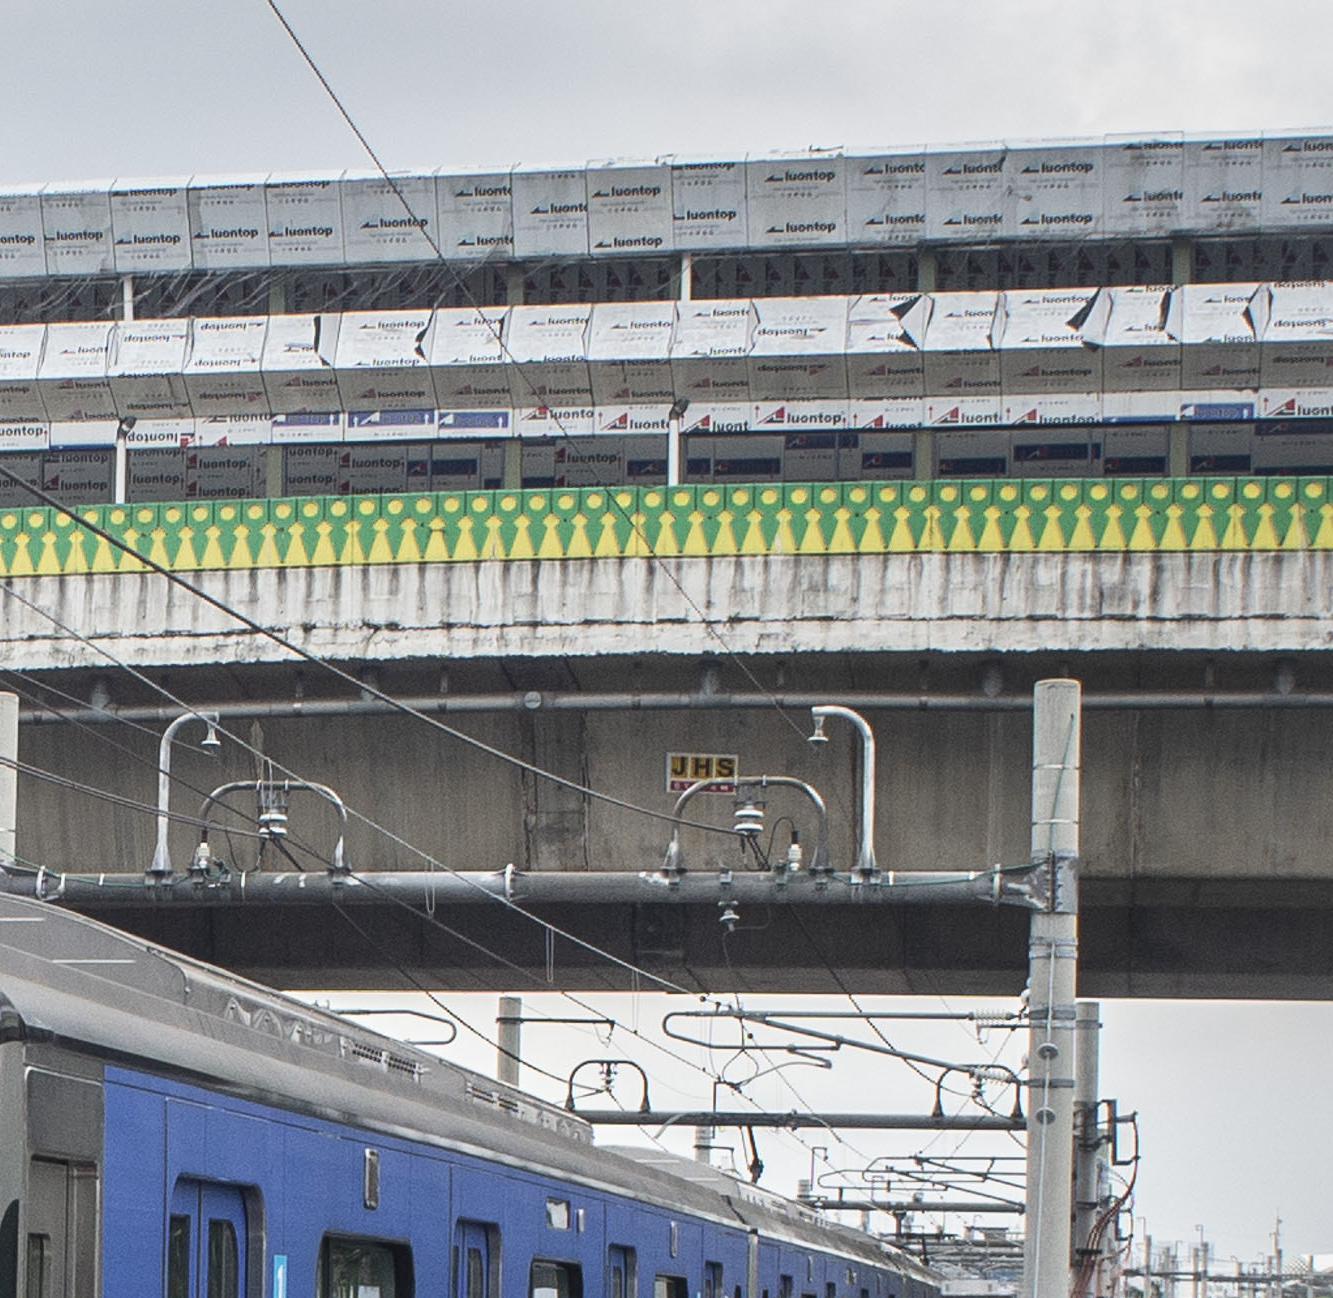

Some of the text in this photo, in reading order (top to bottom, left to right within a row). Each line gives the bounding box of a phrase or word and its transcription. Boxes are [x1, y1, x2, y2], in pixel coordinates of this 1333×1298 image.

[1040, 161, 1094, 174] luontop
[785, 169, 836, 183] luontop
[611, 185, 661, 198] luontop
[686, 208, 736, 221] luontop
[1040, 213, 1093, 225] luontop
[380, 216, 429, 230] luontop
[785, 220, 836, 233] luontop
[56, 229, 103, 242] luontop
[210, 227, 259, 239] luontop
[285, 225, 333, 238] luontop
[133, 233, 181, 245] luontop
[613, 236, 663, 248] luontop
[786, 411, 843, 425] luontop
[61, 452, 108, 465] luontop
[198, 459, 246, 471] luontop
[60, 480, 108, 492] luontop
[288, 473, 335, 486] uontop
[671, 756, 735, 777] JHS
